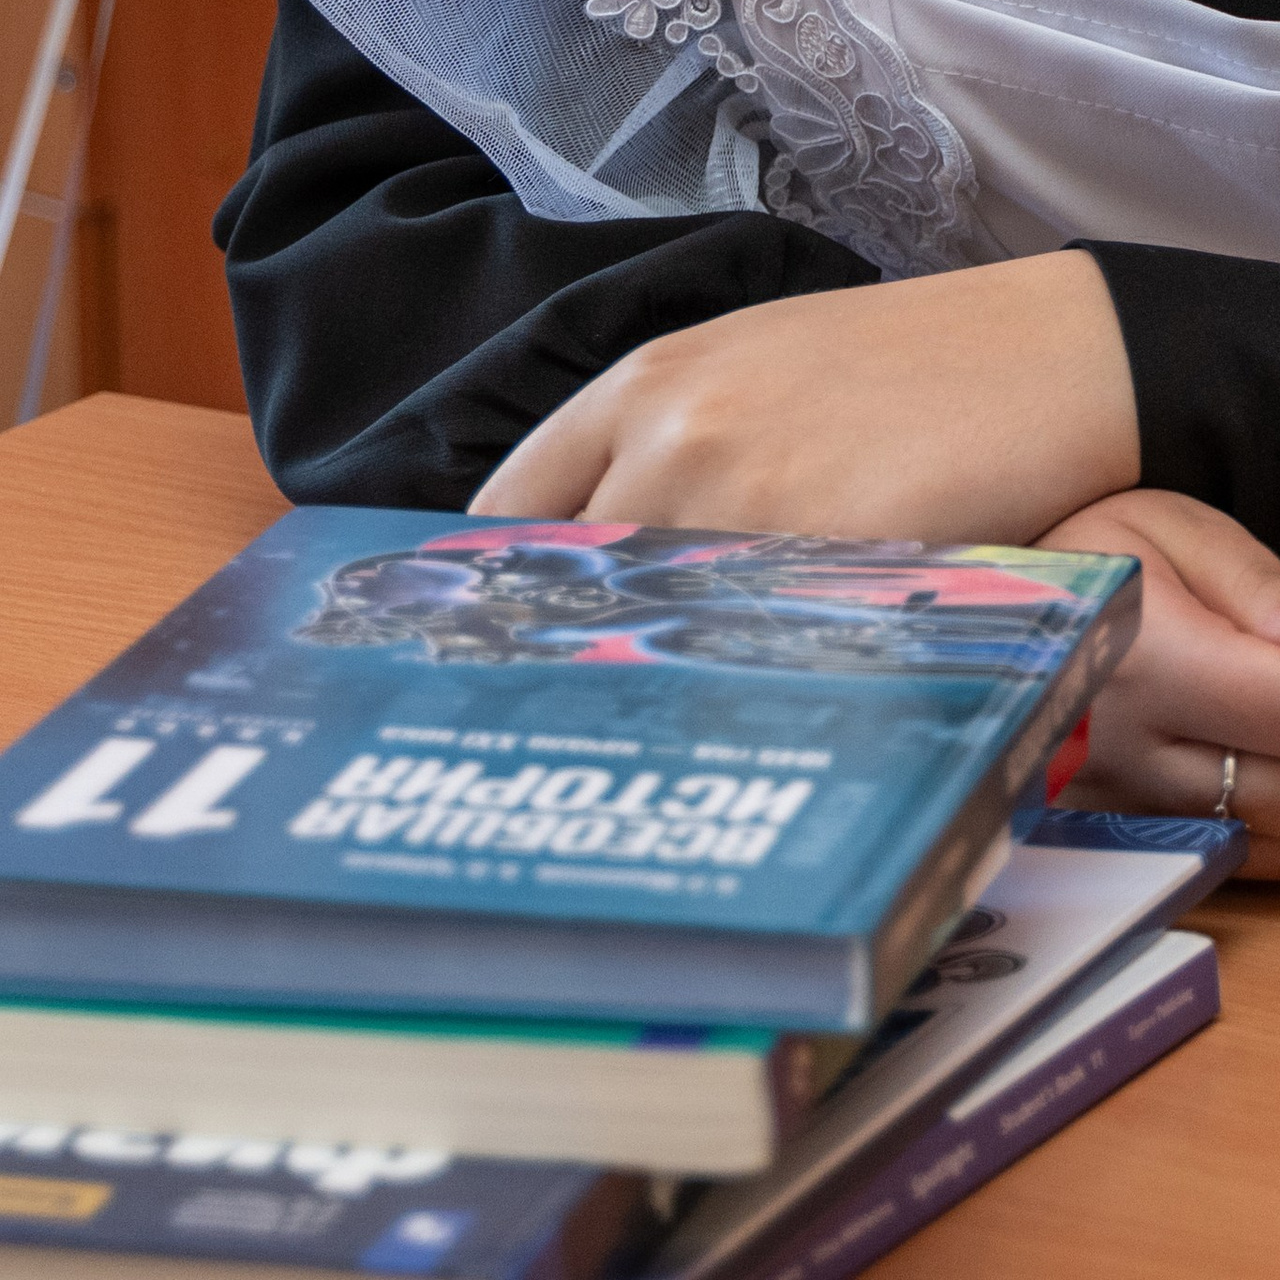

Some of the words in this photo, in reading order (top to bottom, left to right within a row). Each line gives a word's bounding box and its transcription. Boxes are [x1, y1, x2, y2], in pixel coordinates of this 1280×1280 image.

[13, 736, 268, 836] 11
[322, 753, 816, 826] ИСТОРИЯ
[286, 797, 781, 866] ВСЕОБЩАЯ
